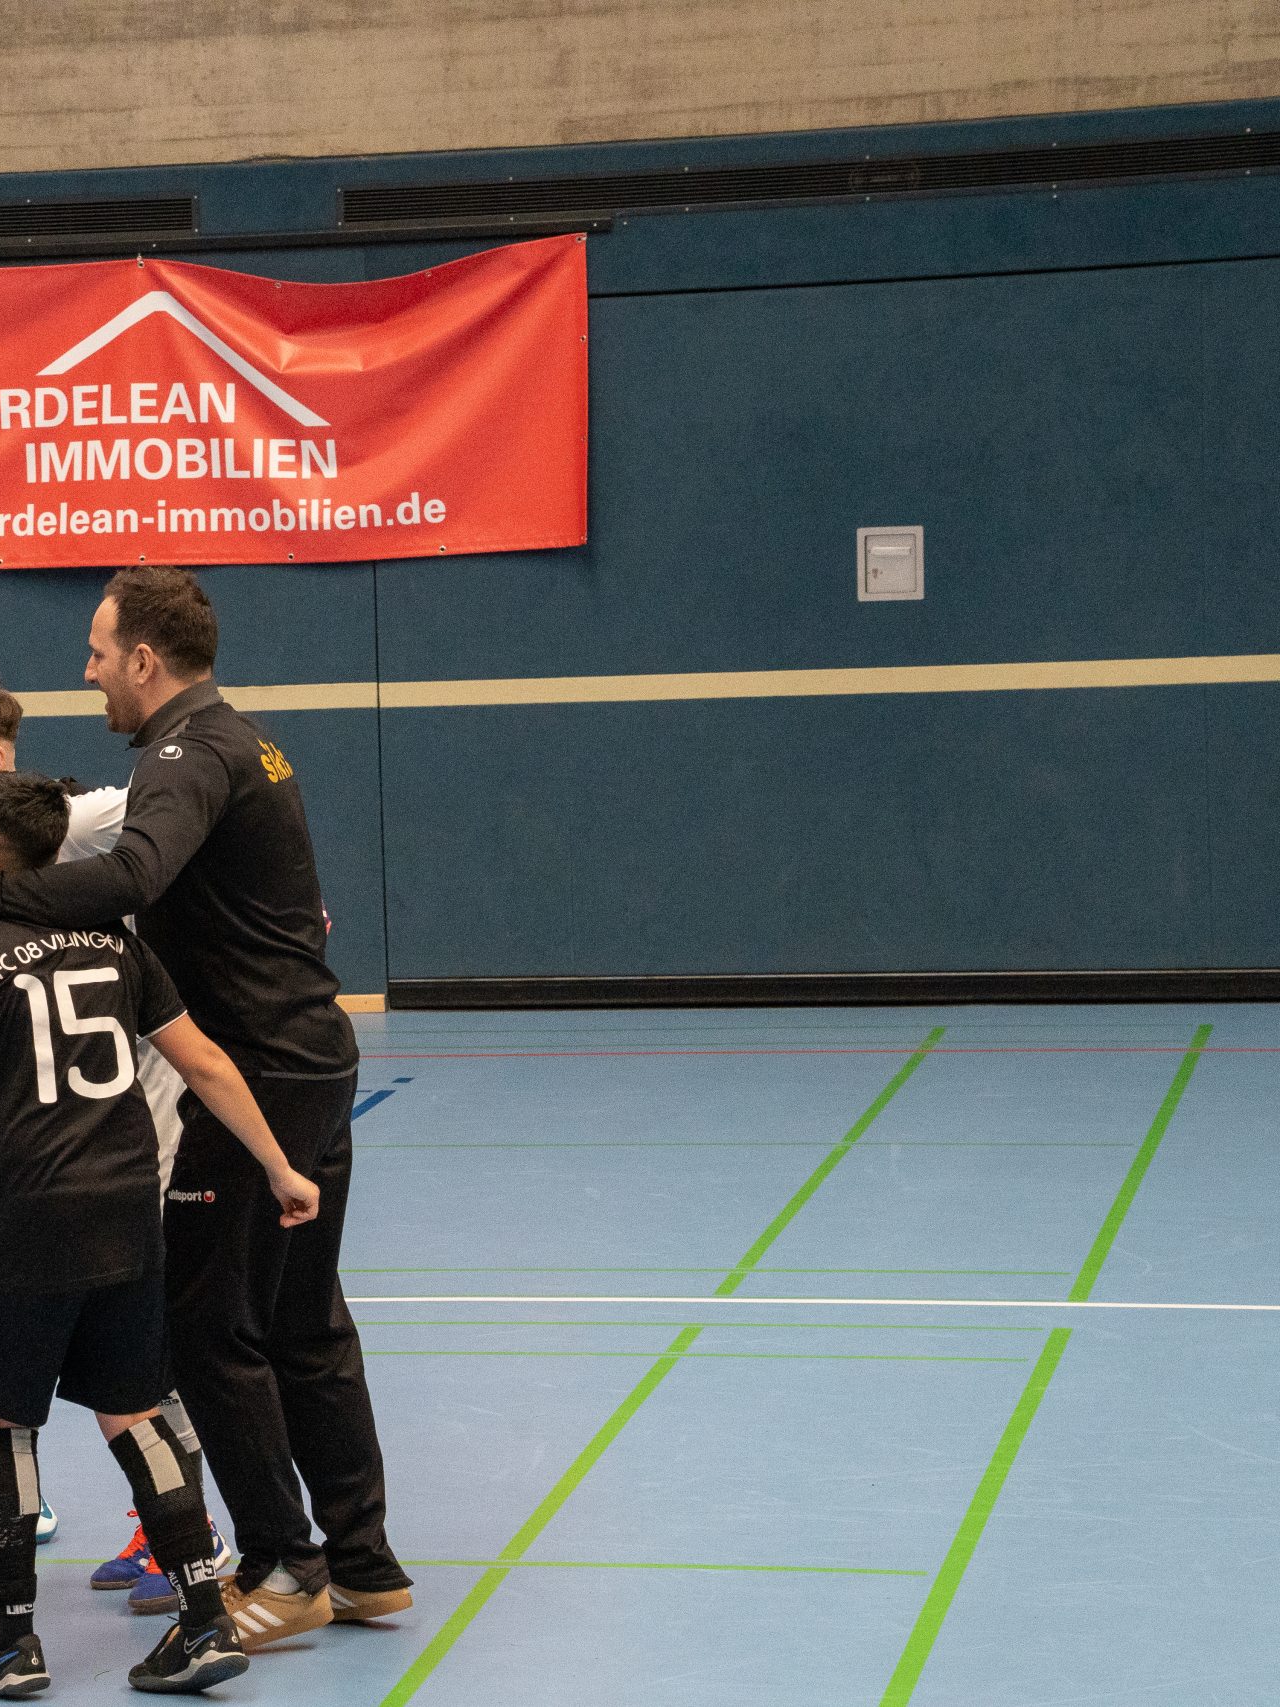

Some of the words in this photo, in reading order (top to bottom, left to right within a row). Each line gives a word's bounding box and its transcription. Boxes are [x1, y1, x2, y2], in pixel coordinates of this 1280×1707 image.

[25, 437, 338, 484] IMMOBILIEN
[14, 942, 43, 964] 08
[13, 967, 135, 1104] 15
[168, 1189, 202, 1203] uhlsport
